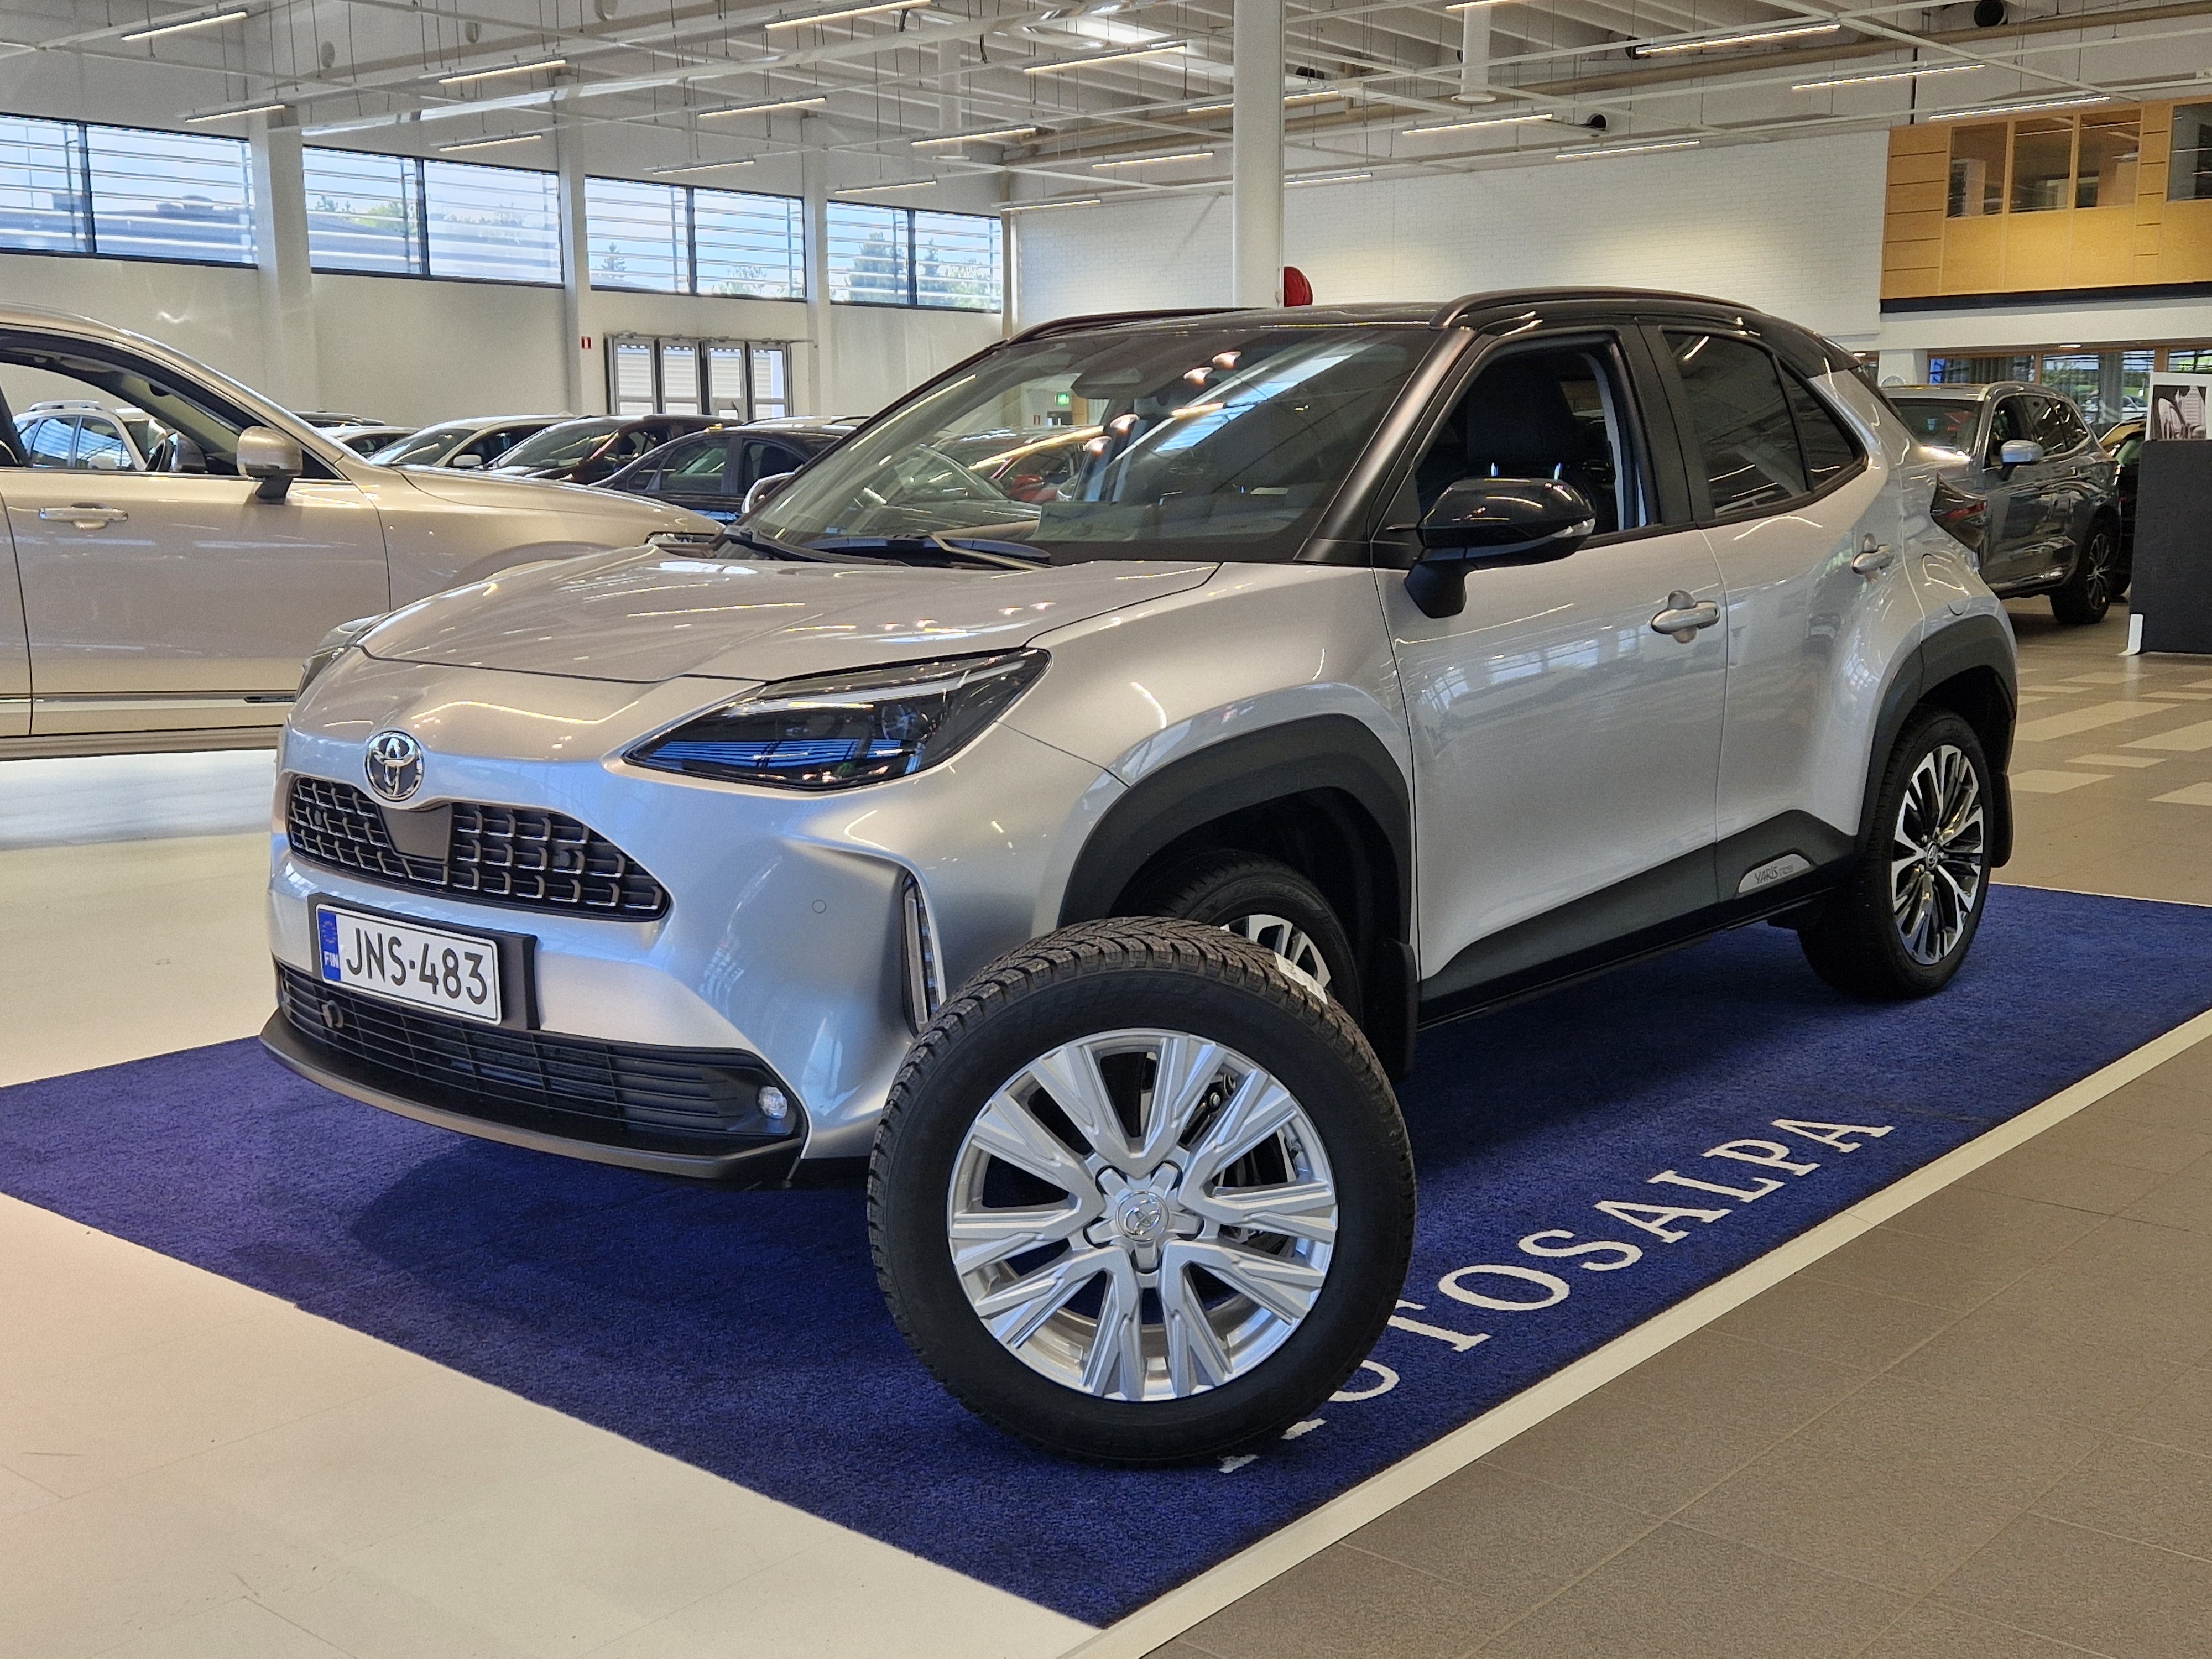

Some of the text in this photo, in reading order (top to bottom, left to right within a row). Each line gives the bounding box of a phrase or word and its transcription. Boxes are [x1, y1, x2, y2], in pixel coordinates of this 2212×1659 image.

[1755, 865, 1778, 884] YARIS
[324, 951, 339, 968] FIN
[346, 927, 487, 1005] JNS-483
[1218, 1119, 1895, 1474] TOSALPA
